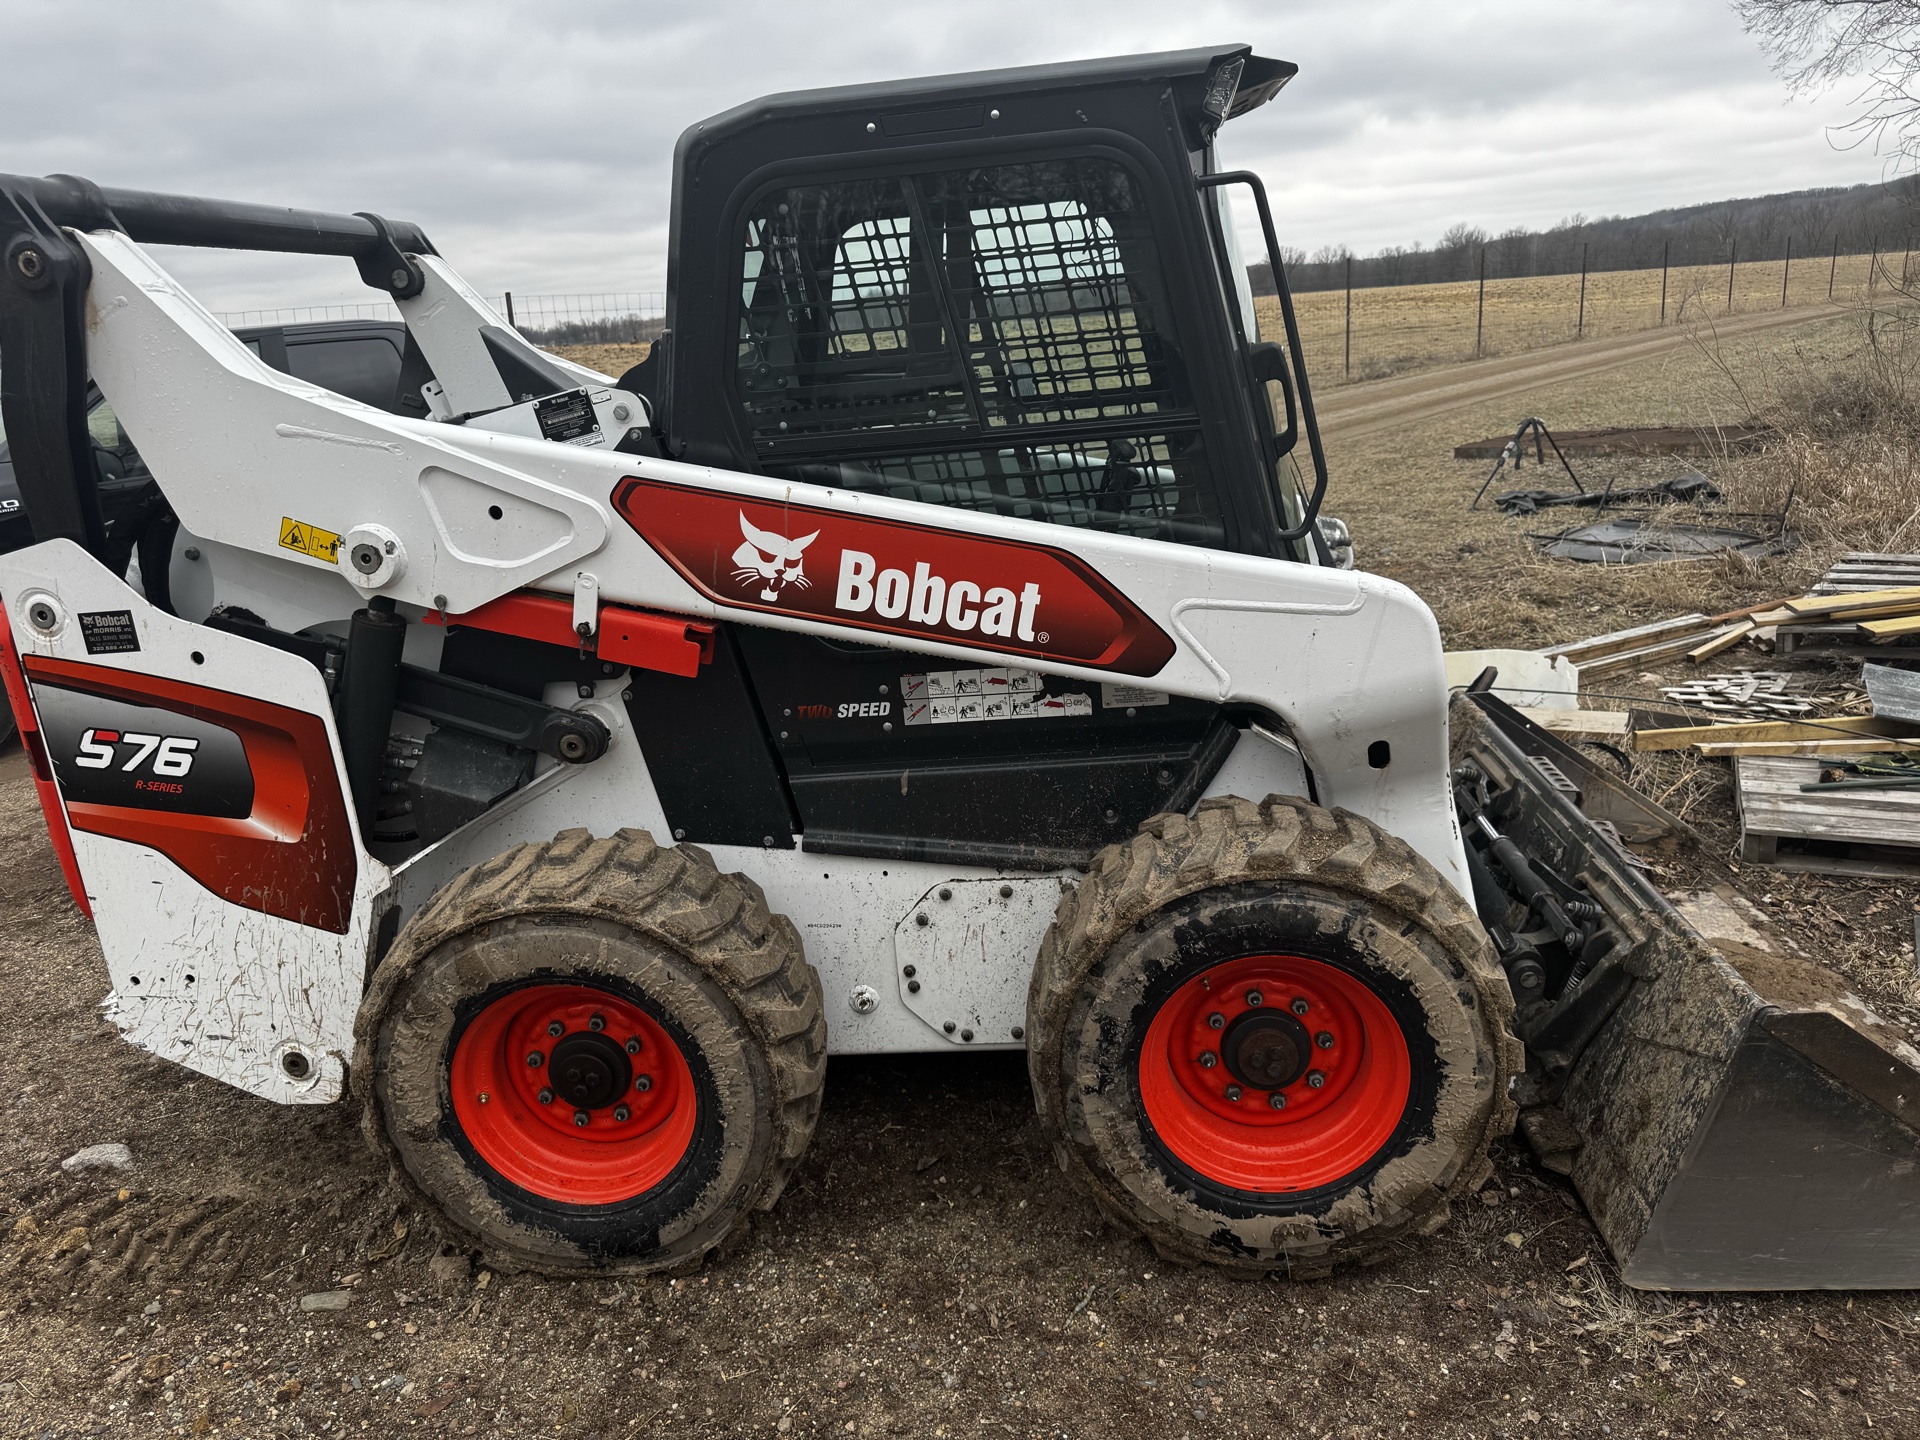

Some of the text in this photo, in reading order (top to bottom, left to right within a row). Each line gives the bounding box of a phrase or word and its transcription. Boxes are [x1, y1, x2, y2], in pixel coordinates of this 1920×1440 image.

[835, 549, 1041, 643] Bobcat
[94, 614, 130, 627] Bobcat
[797, 702, 891, 719] TWO SPEED
[75, 729, 199, 777] S76
[135, 780, 183, 794] R-SERIES
